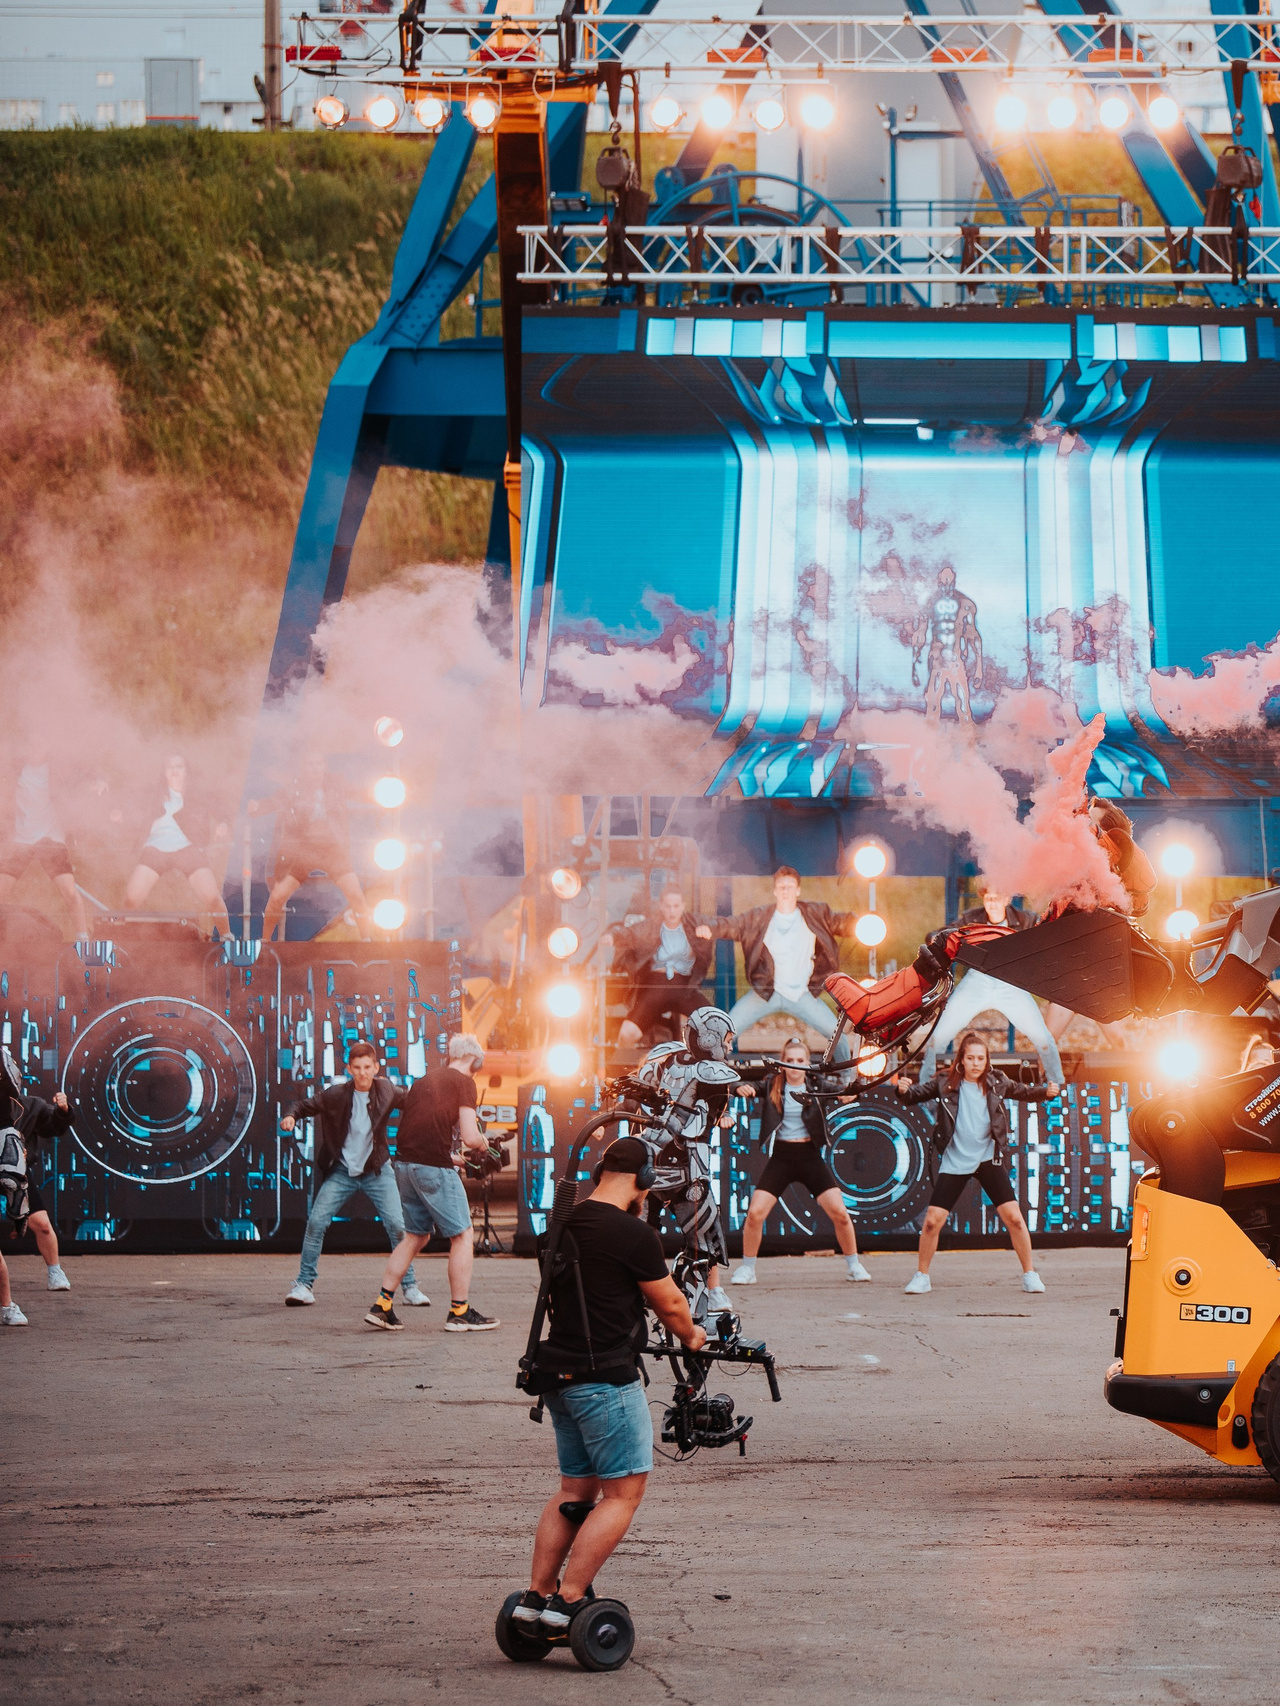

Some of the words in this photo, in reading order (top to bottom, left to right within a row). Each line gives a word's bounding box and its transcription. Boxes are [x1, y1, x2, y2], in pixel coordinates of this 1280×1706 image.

[476, 1105, 517, 1123] CB
[1255, 1098, 1272, 1114] 800
[1196, 1305, 1249, 1324] 300
